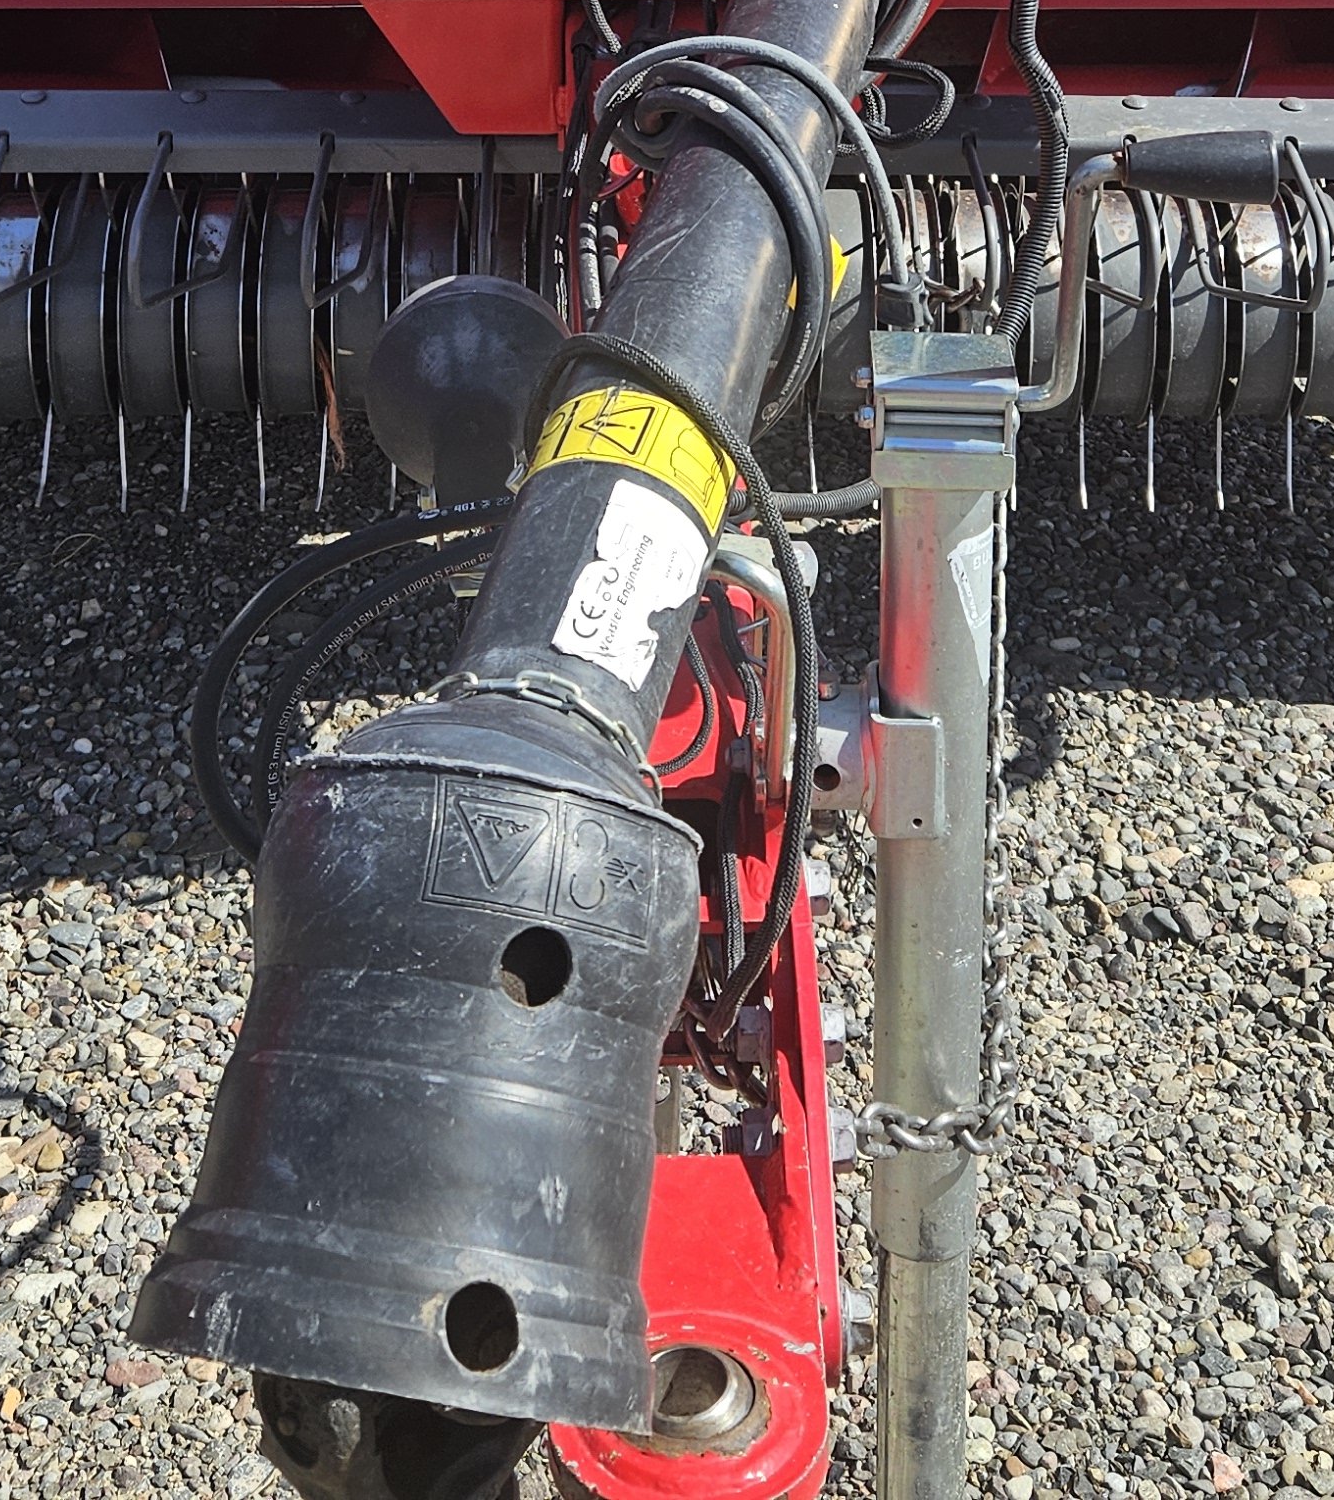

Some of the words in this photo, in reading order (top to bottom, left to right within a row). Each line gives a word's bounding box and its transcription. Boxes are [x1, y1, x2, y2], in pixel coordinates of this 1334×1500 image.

[617, 534, 653, 606] Engineering
[277, 683, 305, 730] ISO1436
[302, 661, 320, 682] 1SN
[352, 609, 374, 628] 1SN
[402, 570, 443, 595] 100R1S
[444, 558, 477, 576] Flame
